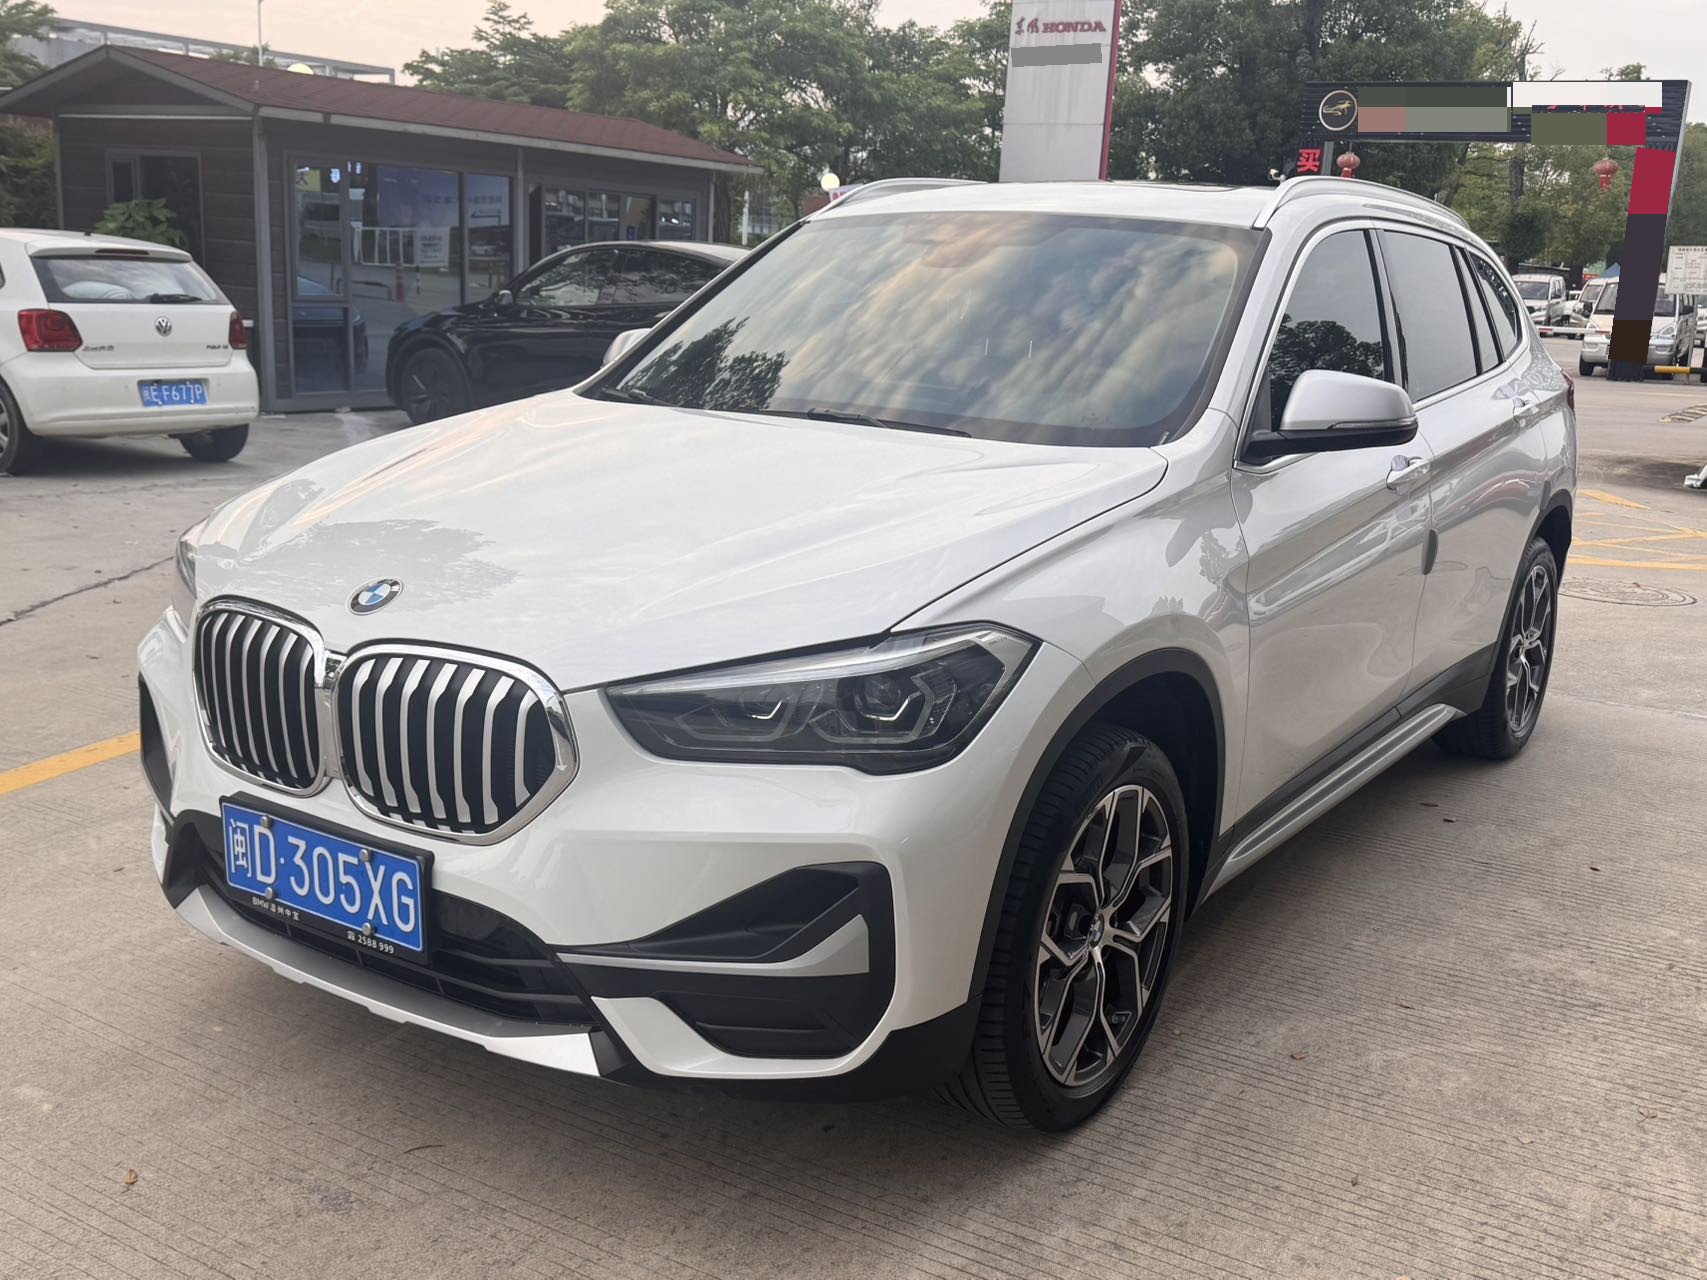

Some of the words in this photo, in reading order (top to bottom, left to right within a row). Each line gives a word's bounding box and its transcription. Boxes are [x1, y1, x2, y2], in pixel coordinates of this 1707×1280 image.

[1042, 21, 1106, 33] HONDA
[1296, 148, 1321, 173] 买
[252, 896, 270, 909] BMW
[357, 934, 378, 949] 2588
[378, 941, 395, 954] 999
